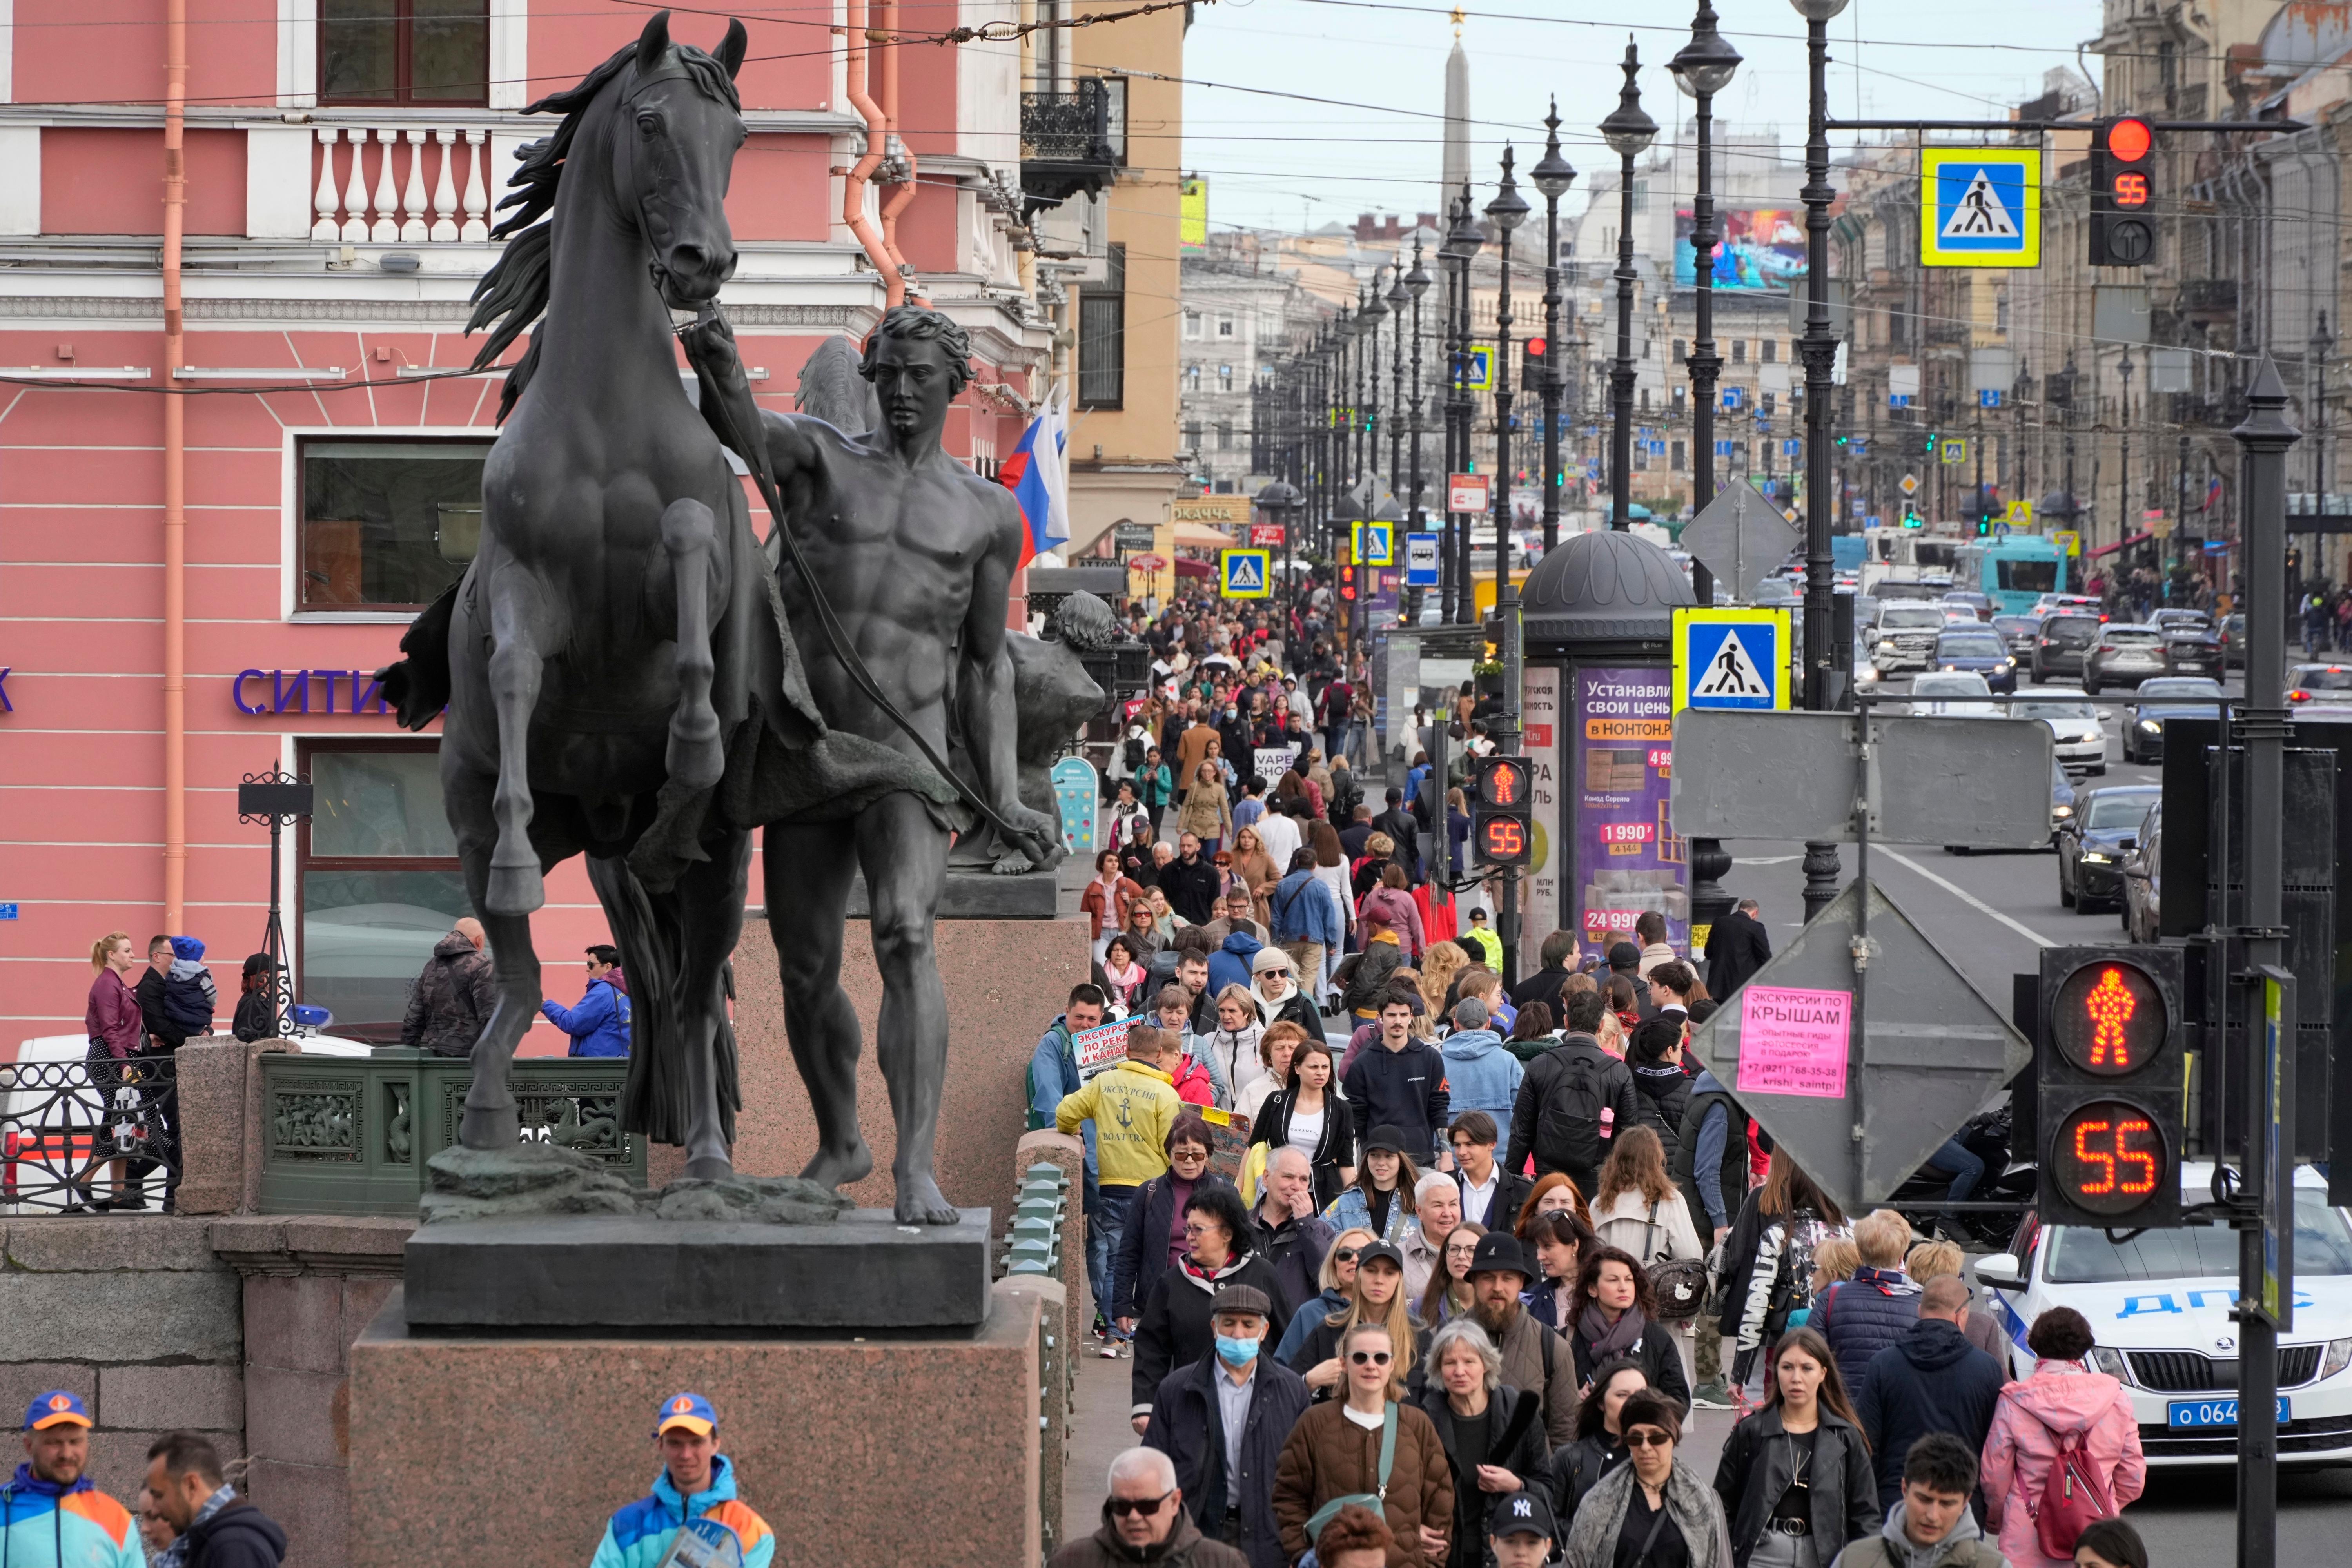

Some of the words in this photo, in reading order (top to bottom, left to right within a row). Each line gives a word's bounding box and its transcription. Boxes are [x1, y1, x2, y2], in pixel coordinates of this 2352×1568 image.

[2116, 176, 2146, 203] 55
[1586, 701, 1629, 713] свои
[1256, 755, 1292, 764] VAPE
[1650, 751, 1658, 764] 4
[1490, 823, 1521, 853] 55
[1605, 826, 1612, 840] 1
[1588, 913, 1607, 927] 24
[1752, 993, 1821, 1005] ЭКСКУРСИИ
[1825, 998, 1841, 1007] ПО
[1751, 1006, 1840, 1025] КРЫШАМ
[1078, 1019, 1141, 1044] ЭКСКУРСИИ
[1084, 1042, 1099, 1053] ПО
[1762, 1041, 1819, 1049] ФОТОСЕССИЯ
[1082, 1055, 1089, 1065] И
[1762, 1064, 1786, 1073] (921)
[1790, 1066, 1837, 1076] 768-35-38
[1102, 1085, 1156, 1100] ЭКСКУРСИИ
[1103, 1132, 1127, 1141] BOAT
[2076, 1120, 2155, 1193] 55
[1514, 1499, 1532, 1517] NY
